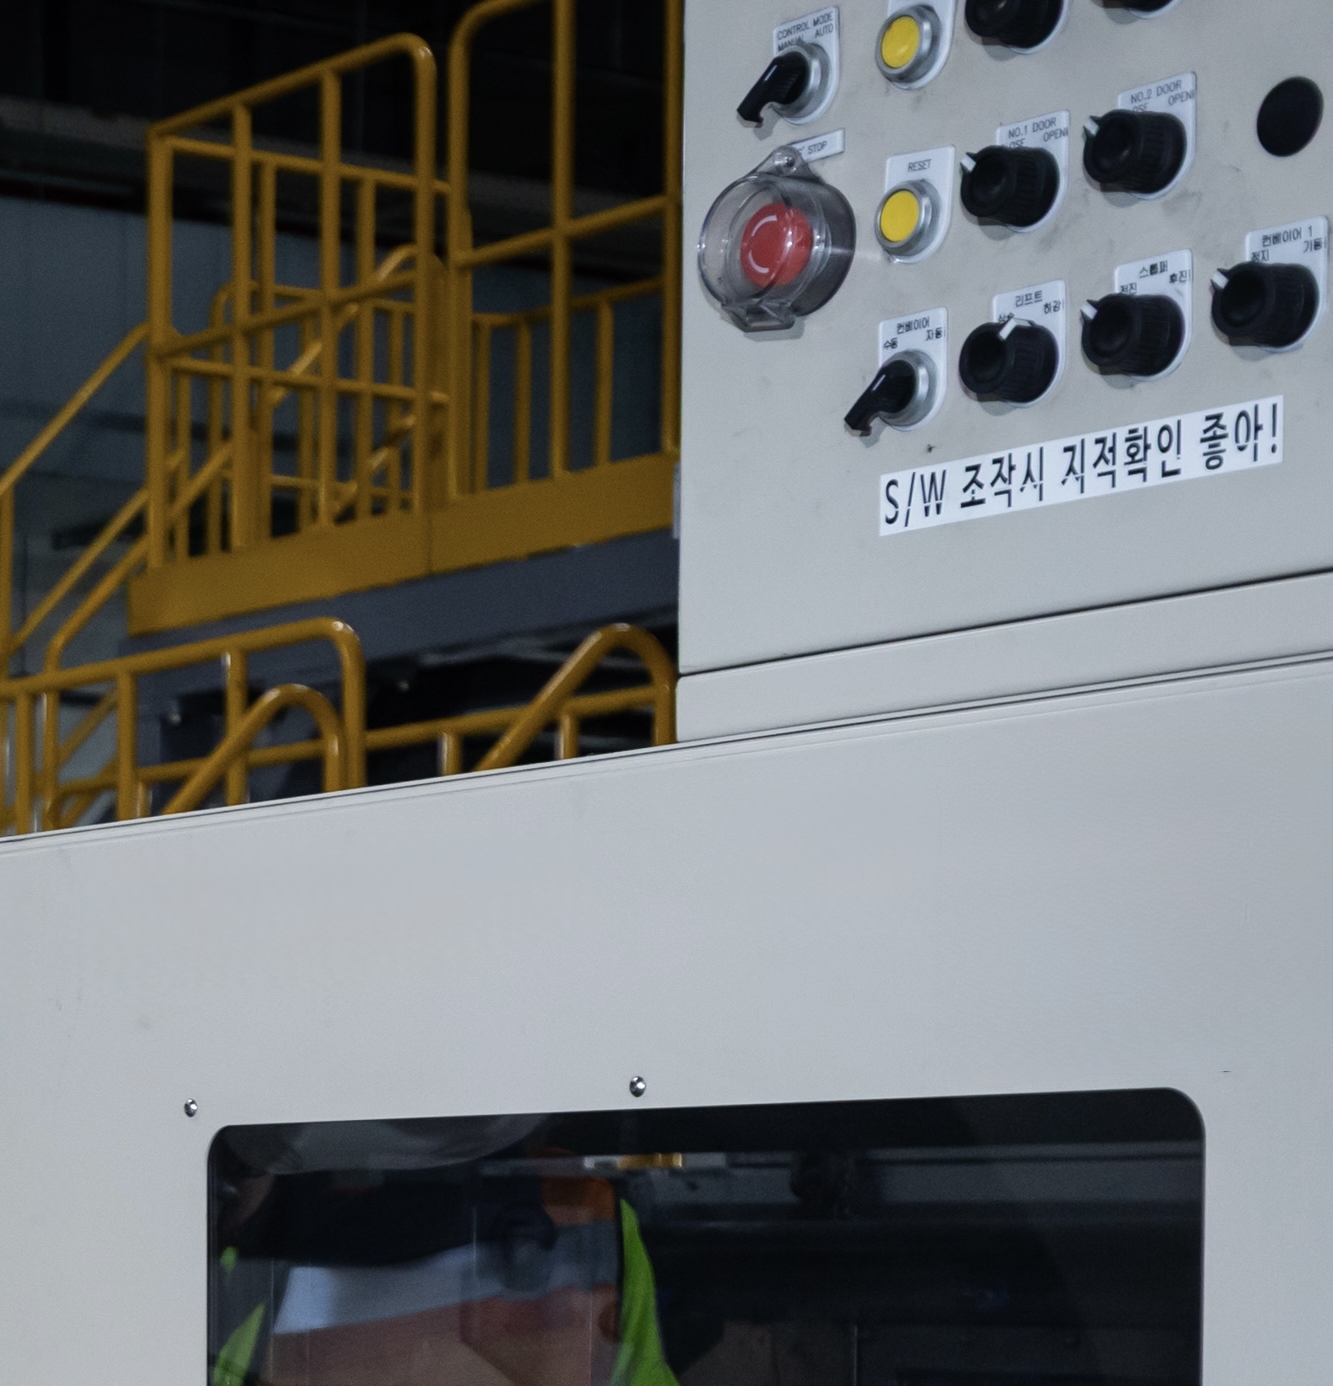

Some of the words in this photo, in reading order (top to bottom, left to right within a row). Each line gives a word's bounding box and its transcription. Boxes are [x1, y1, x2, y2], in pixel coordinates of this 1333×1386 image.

[777, 20, 810, 40] CONTROL
[813, 11, 834, 26] MODE
[815, 23, 834, 38] AUTO
[1130, 88, 1153, 104] NO.2
[1156, 79, 1183, 97] DOOR
[1008, 124, 1028, 139] NO.1
[1033, 117, 1057, 133] DOOR
[807, 140, 828, 155] STOP
[907, 158, 933, 173] RESET
[1261, 227, 1302, 247] 컨베이어
[1015, 290, 1043, 307] 리프트
[896, 316, 930, 334] 컨베이어
[925, 326, 943, 341] 자동
[884, 468, 948, 528] S/W
[960, 446, 1045, 509] 조작시
[1061, 419, 1183, 494] 지적확인
[1199, 402, 1279, 470] 좋아!
